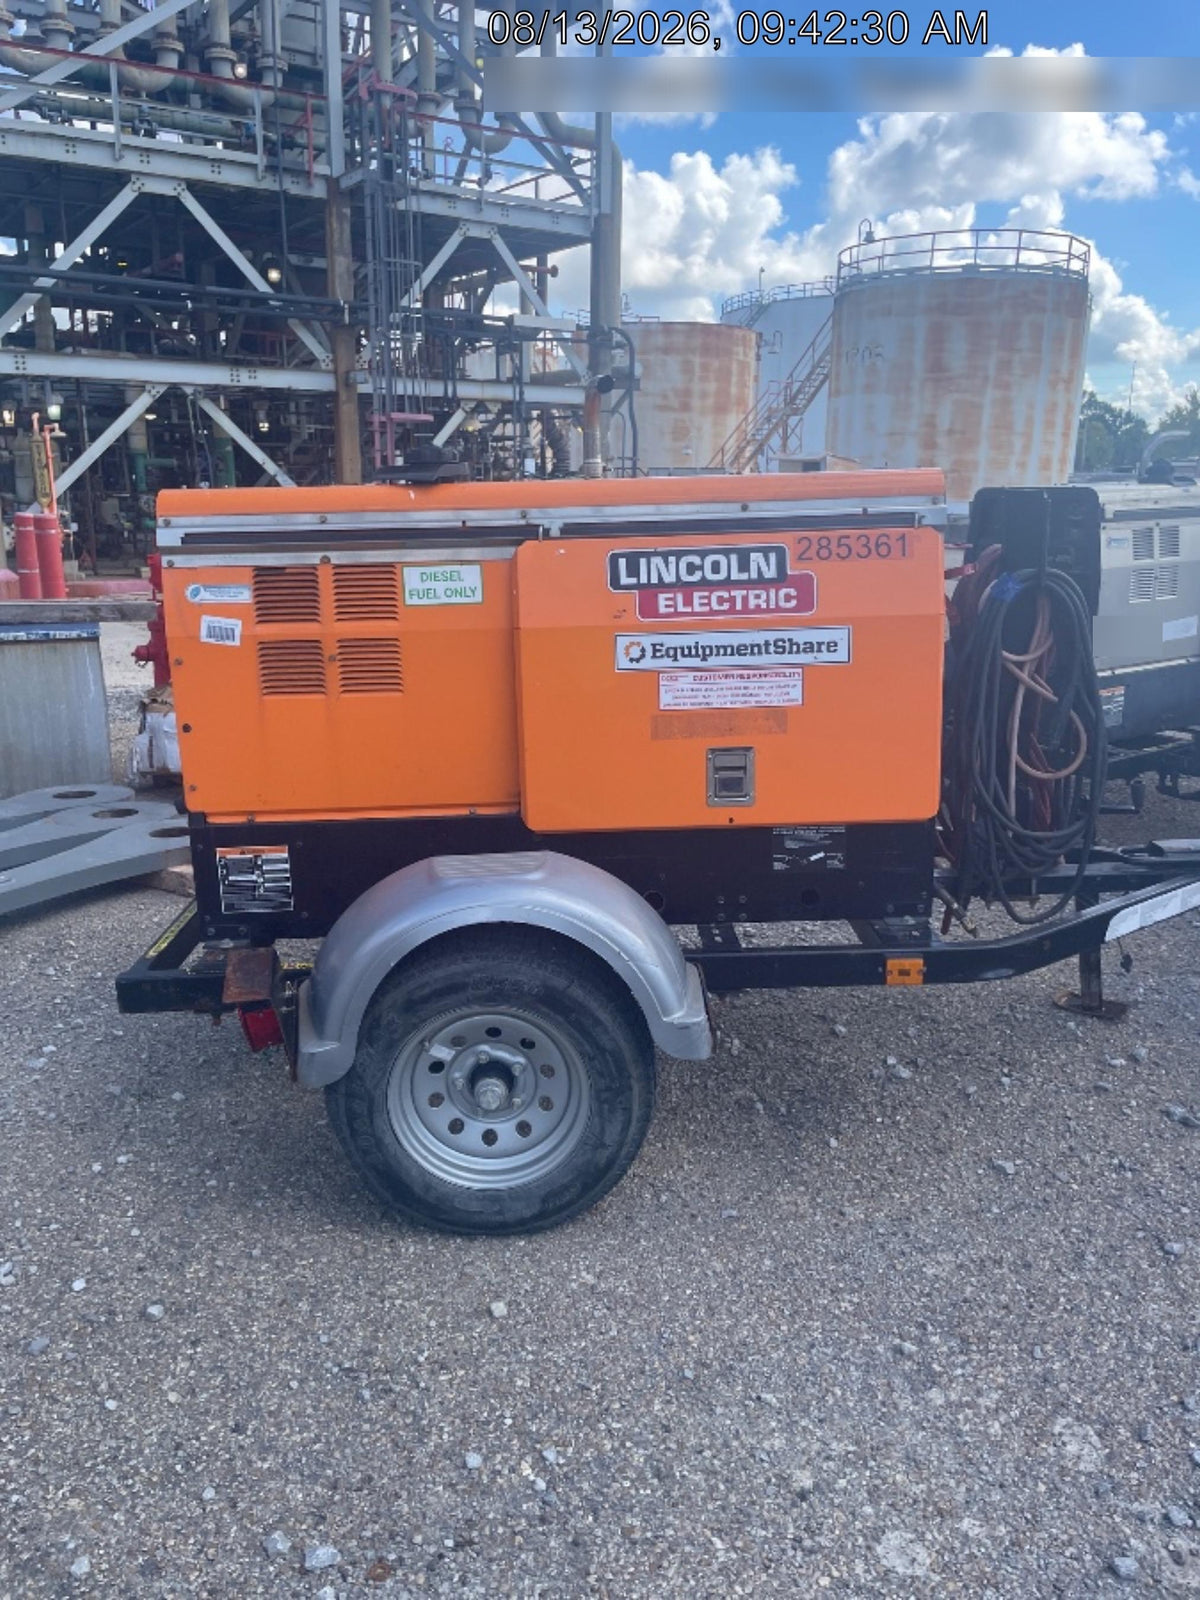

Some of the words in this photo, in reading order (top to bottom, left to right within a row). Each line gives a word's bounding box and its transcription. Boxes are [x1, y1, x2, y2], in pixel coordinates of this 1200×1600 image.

[796, 533, 908, 561] 285361
[420, 570, 464, 582] DIESEL
[618, 552, 778, 585] LINCOLN
[408, 587, 440, 600] FUEL
[444, 586, 477, 598] ONLY
[657, 587, 798, 614] ELECTRIC
[650, 638, 838, 663] EquipmentShare
